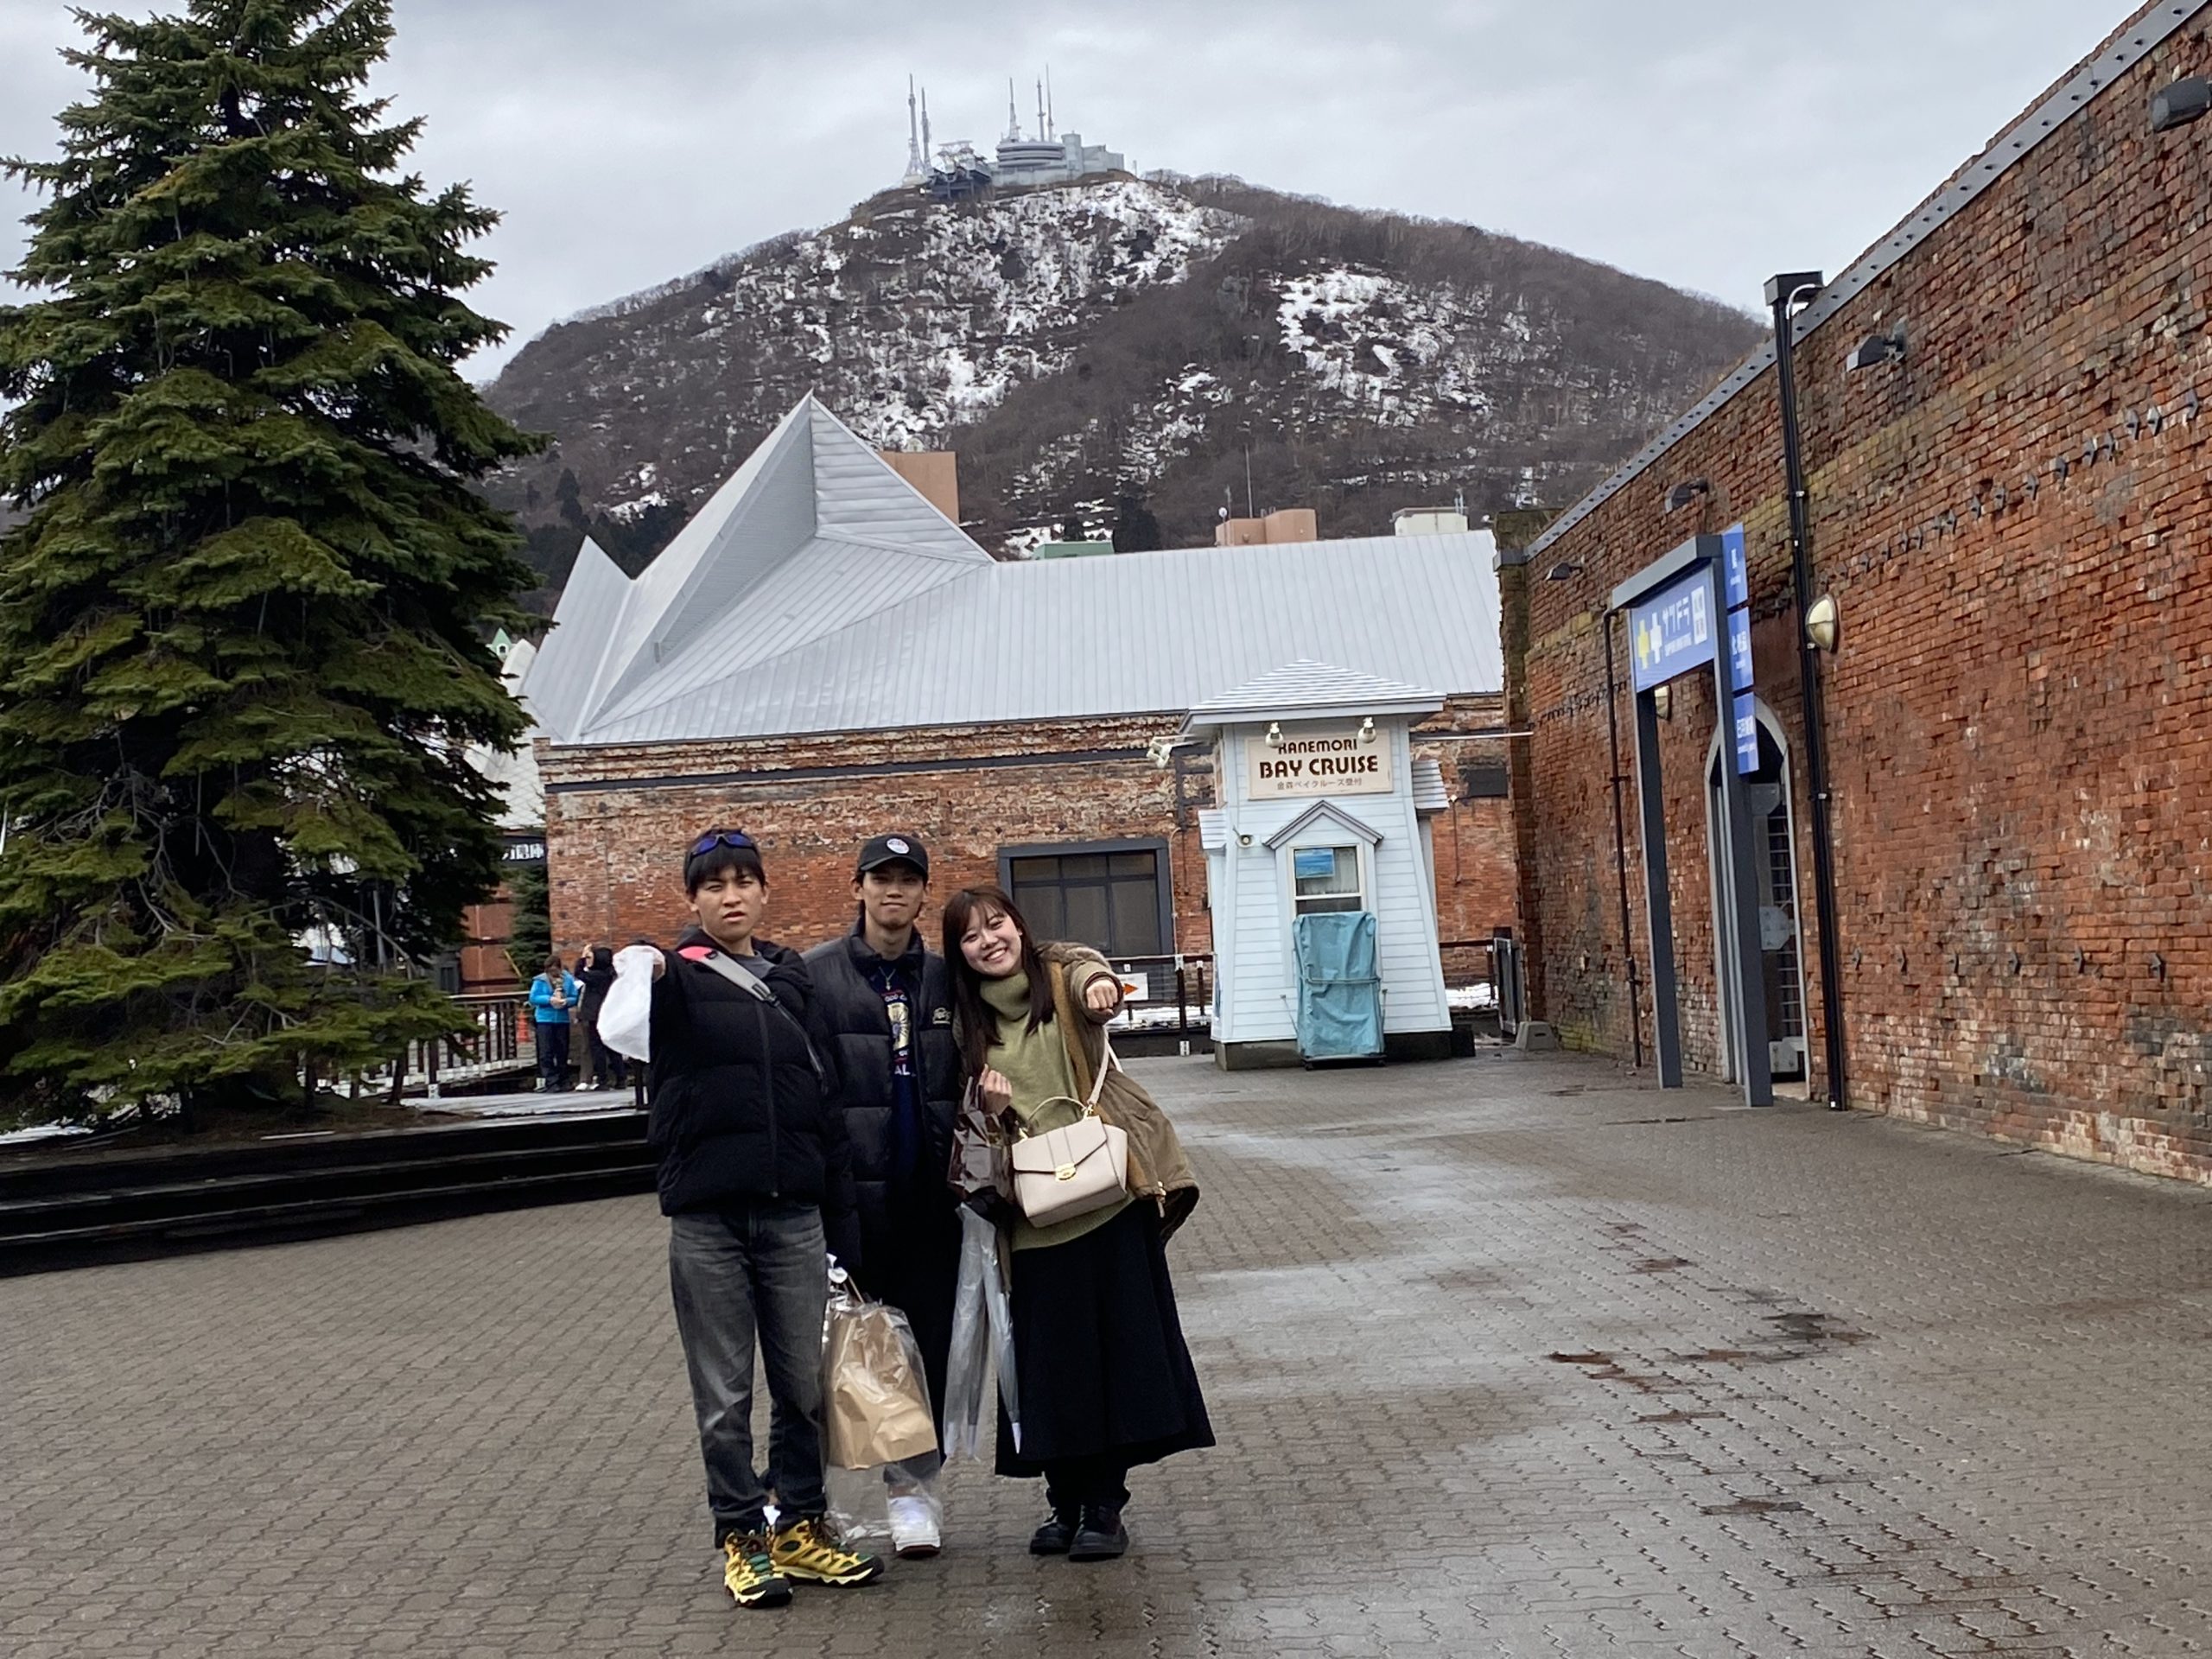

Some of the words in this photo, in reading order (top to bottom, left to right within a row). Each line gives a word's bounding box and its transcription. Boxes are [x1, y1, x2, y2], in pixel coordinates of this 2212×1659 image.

[1278, 739, 1357, 754] KANEMORI
[1259, 760, 1302, 779] BAY
[1308, 754, 1378, 776] CRUISE
